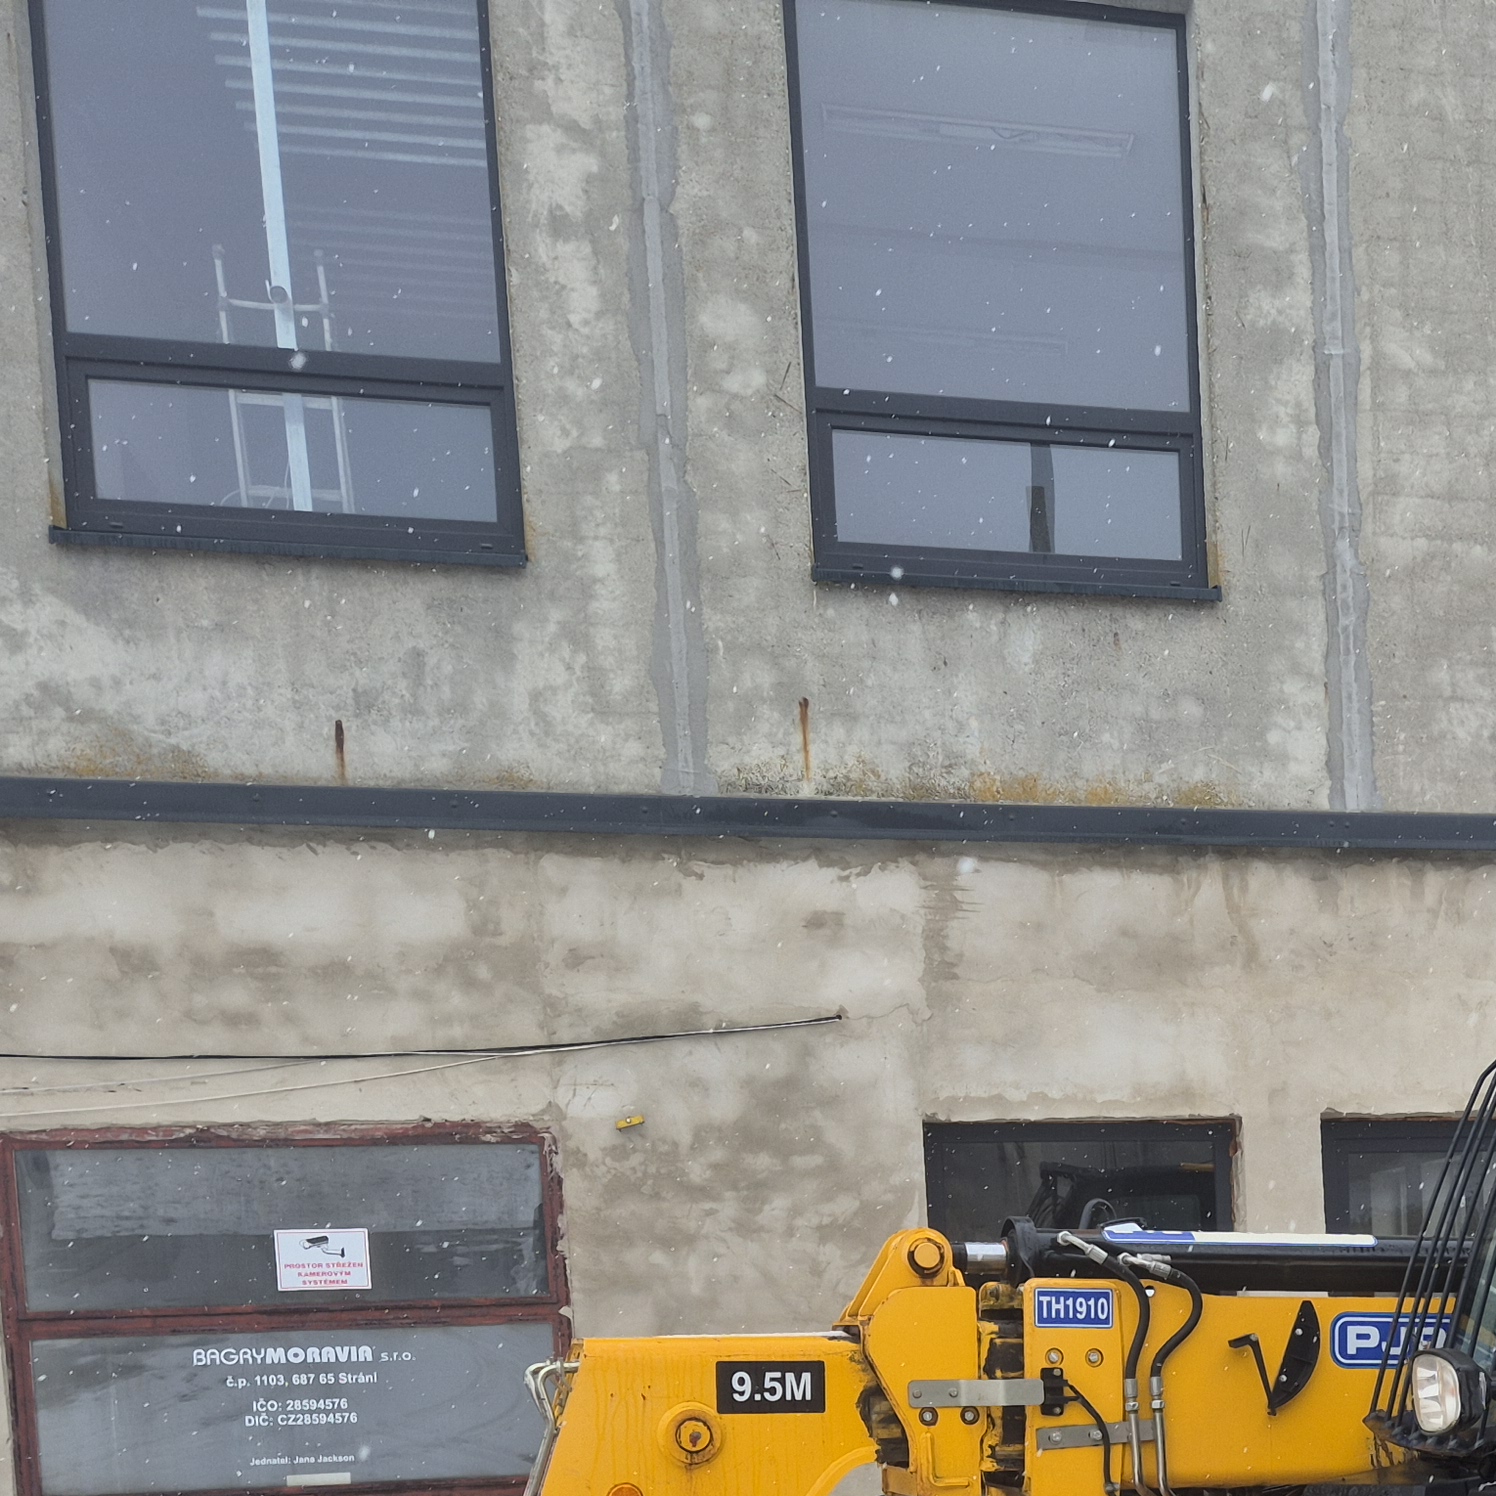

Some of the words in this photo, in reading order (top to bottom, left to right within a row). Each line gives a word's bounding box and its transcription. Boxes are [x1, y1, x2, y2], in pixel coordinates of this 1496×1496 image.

[1039, 1296, 1109, 1320] TH1910
[379, 1351, 417, 1362] s.r.o.
[226, 1375, 250, 1389] č.p.
[254, 1375, 289, 1387] 1103,
[292, 1374, 315, 1385] 687
[319, 1373, 335, 1385] 65
[731, 1371, 812, 1402] 9.5M
[253, 1398, 282, 1412] IČO:
[286, 1398, 348, 1411] 28594576
[245, 1412, 273, 1426] DIČ:
[277, 1412, 358, 1426] CZ28594576
[317, 1454, 355, 1463] Jackson
